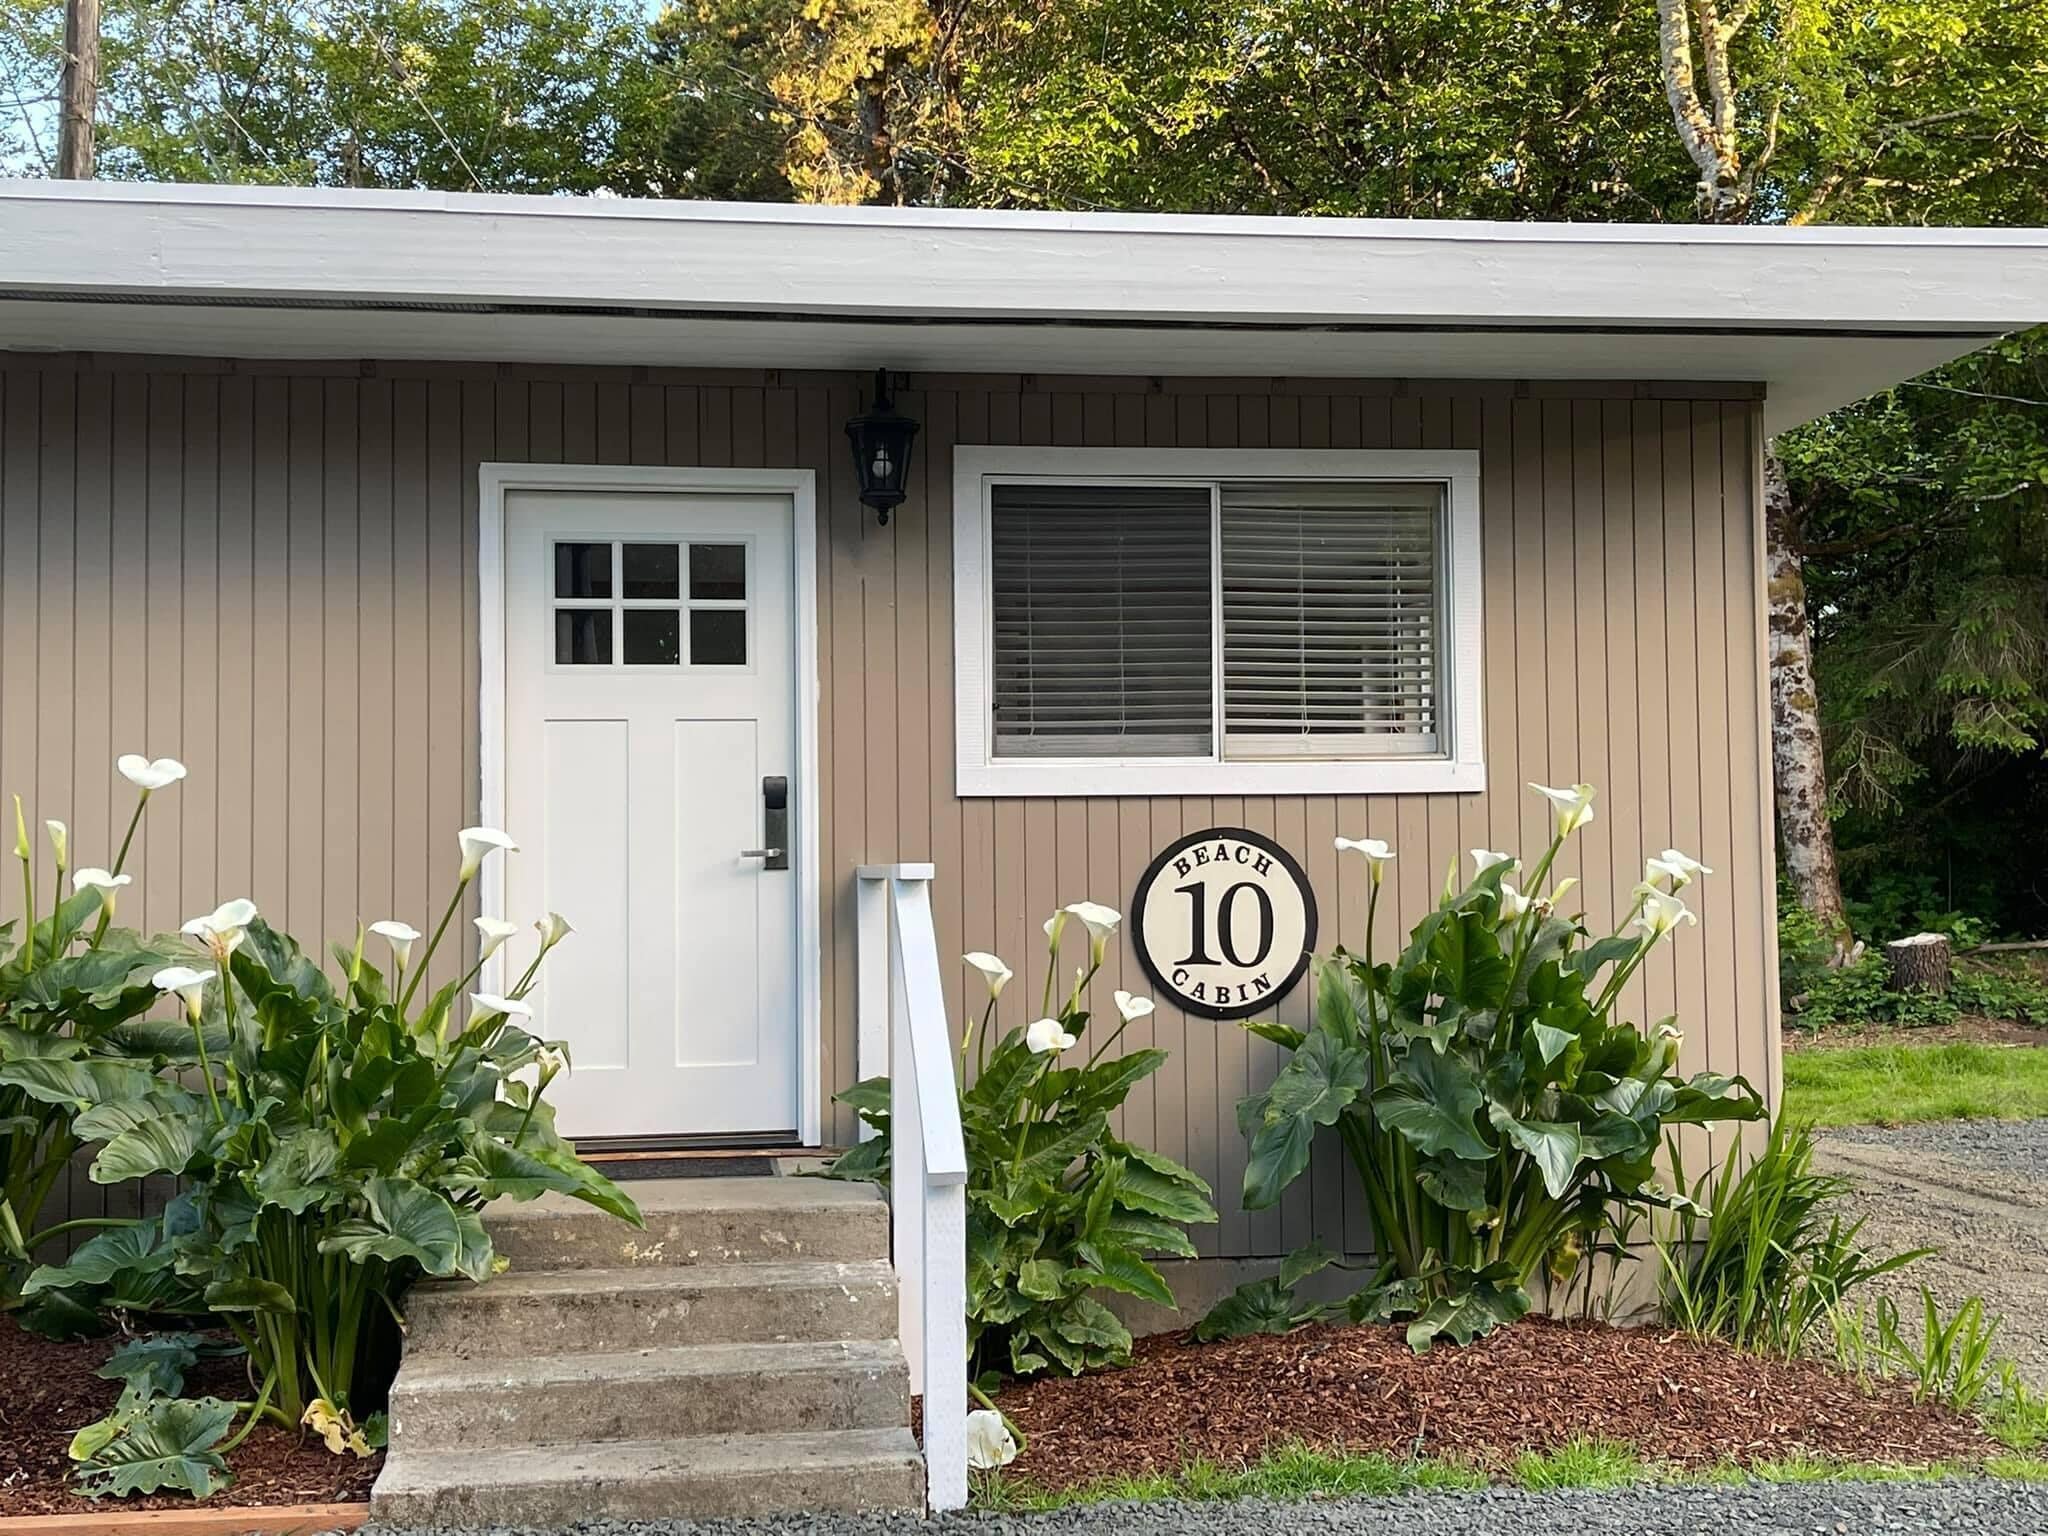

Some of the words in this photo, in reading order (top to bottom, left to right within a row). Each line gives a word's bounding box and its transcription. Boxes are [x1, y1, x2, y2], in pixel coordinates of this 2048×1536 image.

[1173, 843, 1273, 879] BEACH
[1173, 881, 1274, 968] 10
[1172, 968, 1272, 1004] CABIN
